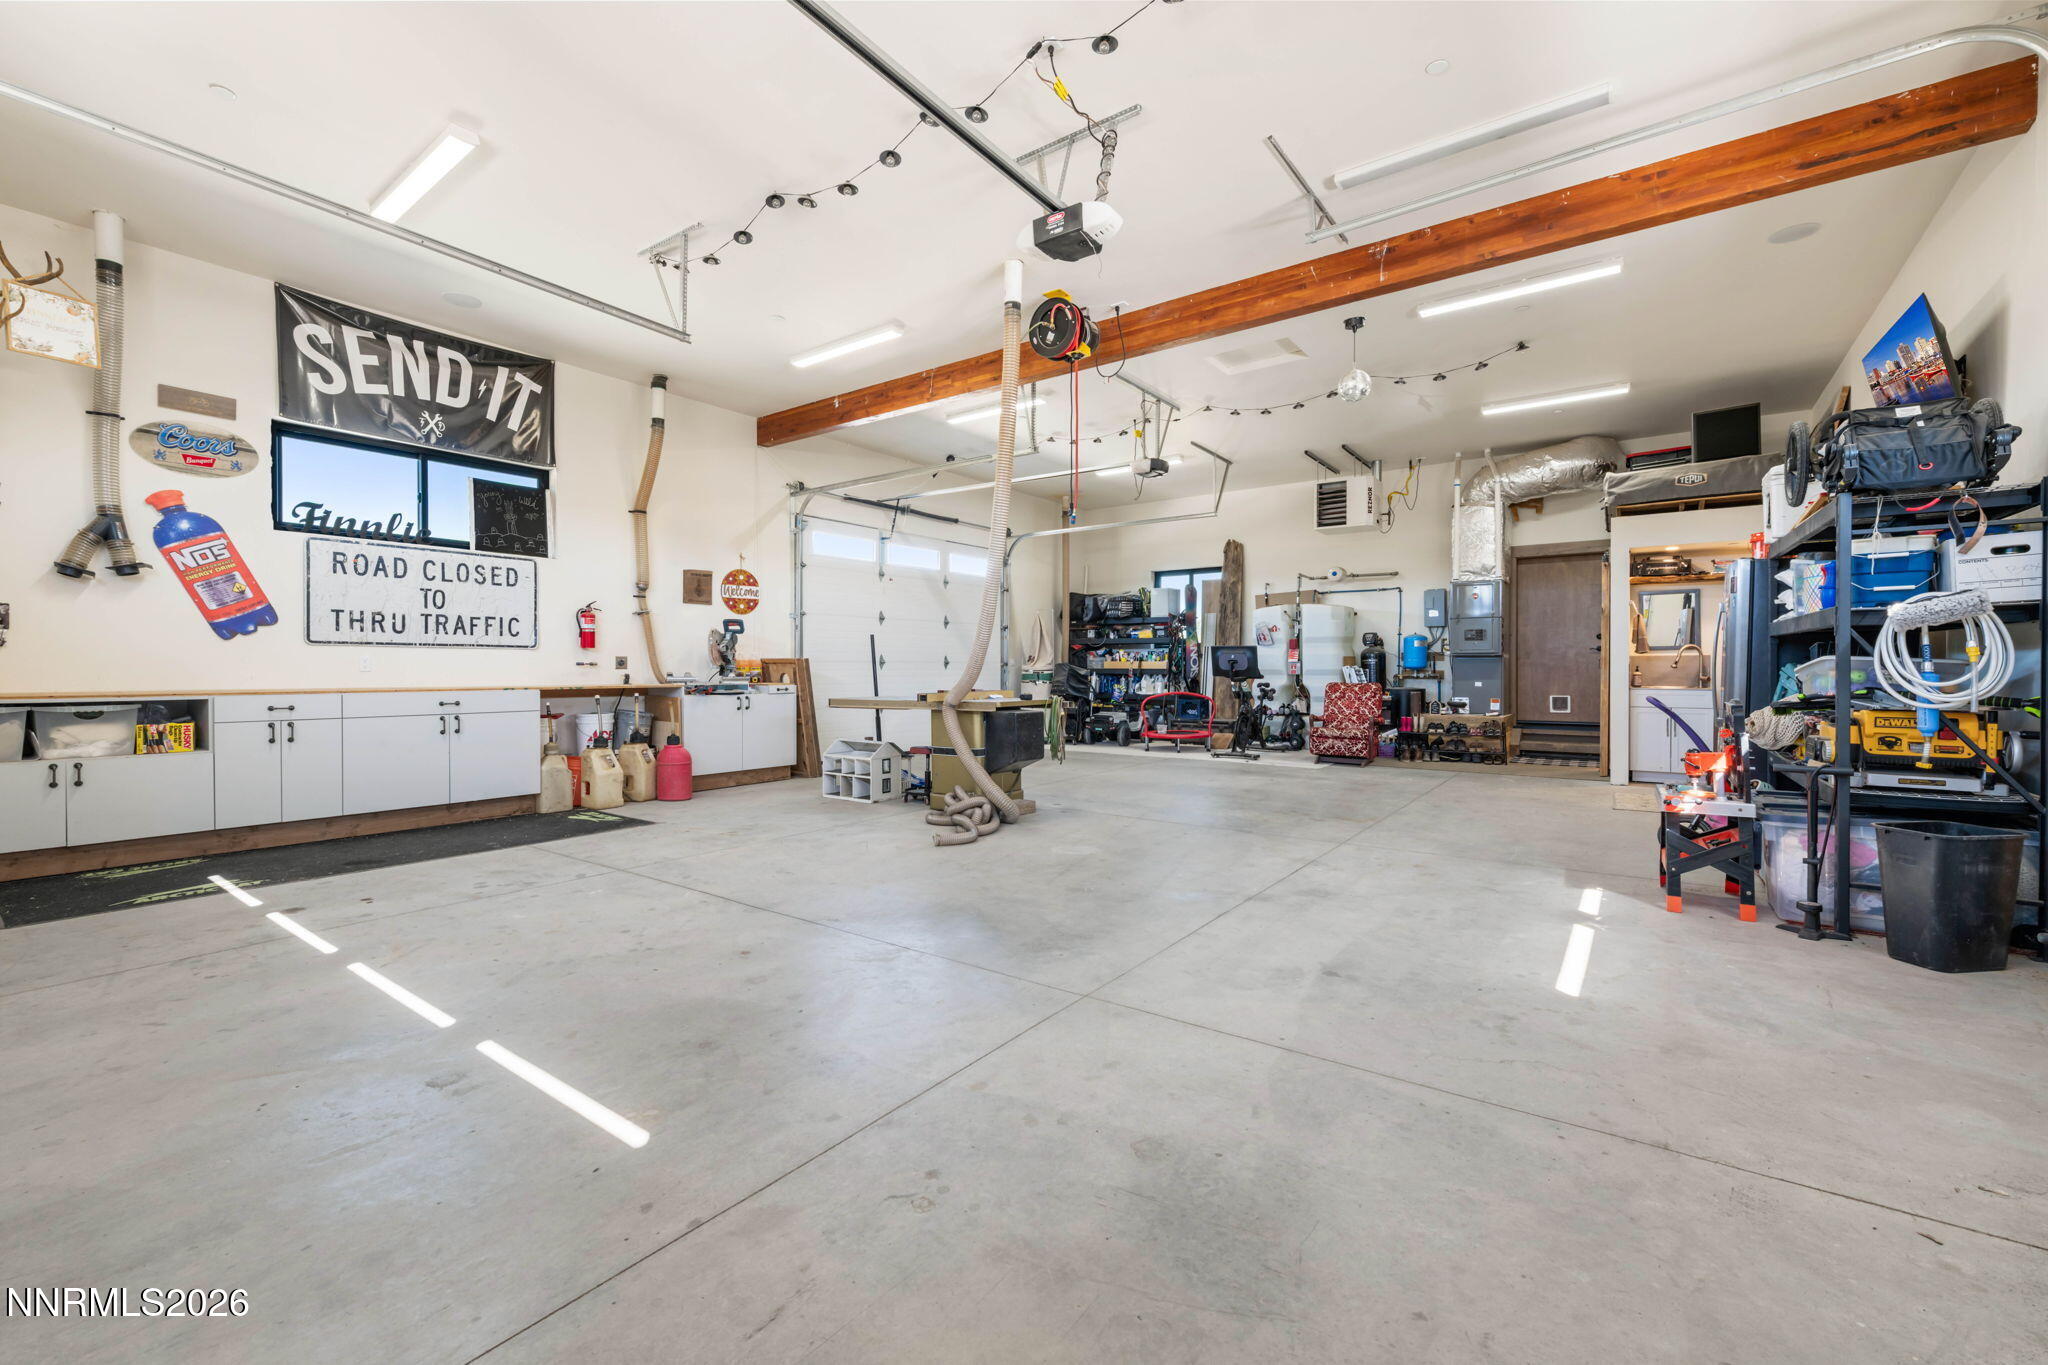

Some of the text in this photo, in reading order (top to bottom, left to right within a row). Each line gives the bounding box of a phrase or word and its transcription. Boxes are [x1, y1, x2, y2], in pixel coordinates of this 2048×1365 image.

[293, 323, 542, 431] SEND IT
[157, 423, 238, 457] Coors
[185, 457, 214, 465] Banquet
[1680, 474, 1703, 484] TEPUI
[169, 537, 232, 571] NOS
[185, 562, 238, 581] ENERGY DRINK
[332, 551, 519, 588] ROAD CLOSED
[420, 588, 446, 610] TO
[720, 583, 760, 598] Welcome
[330, 609, 520, 637] THRU TRAFFIC
[1876, 717, 1919, 727] DEWAL
[183, 725, 191, 749] HUSKY
